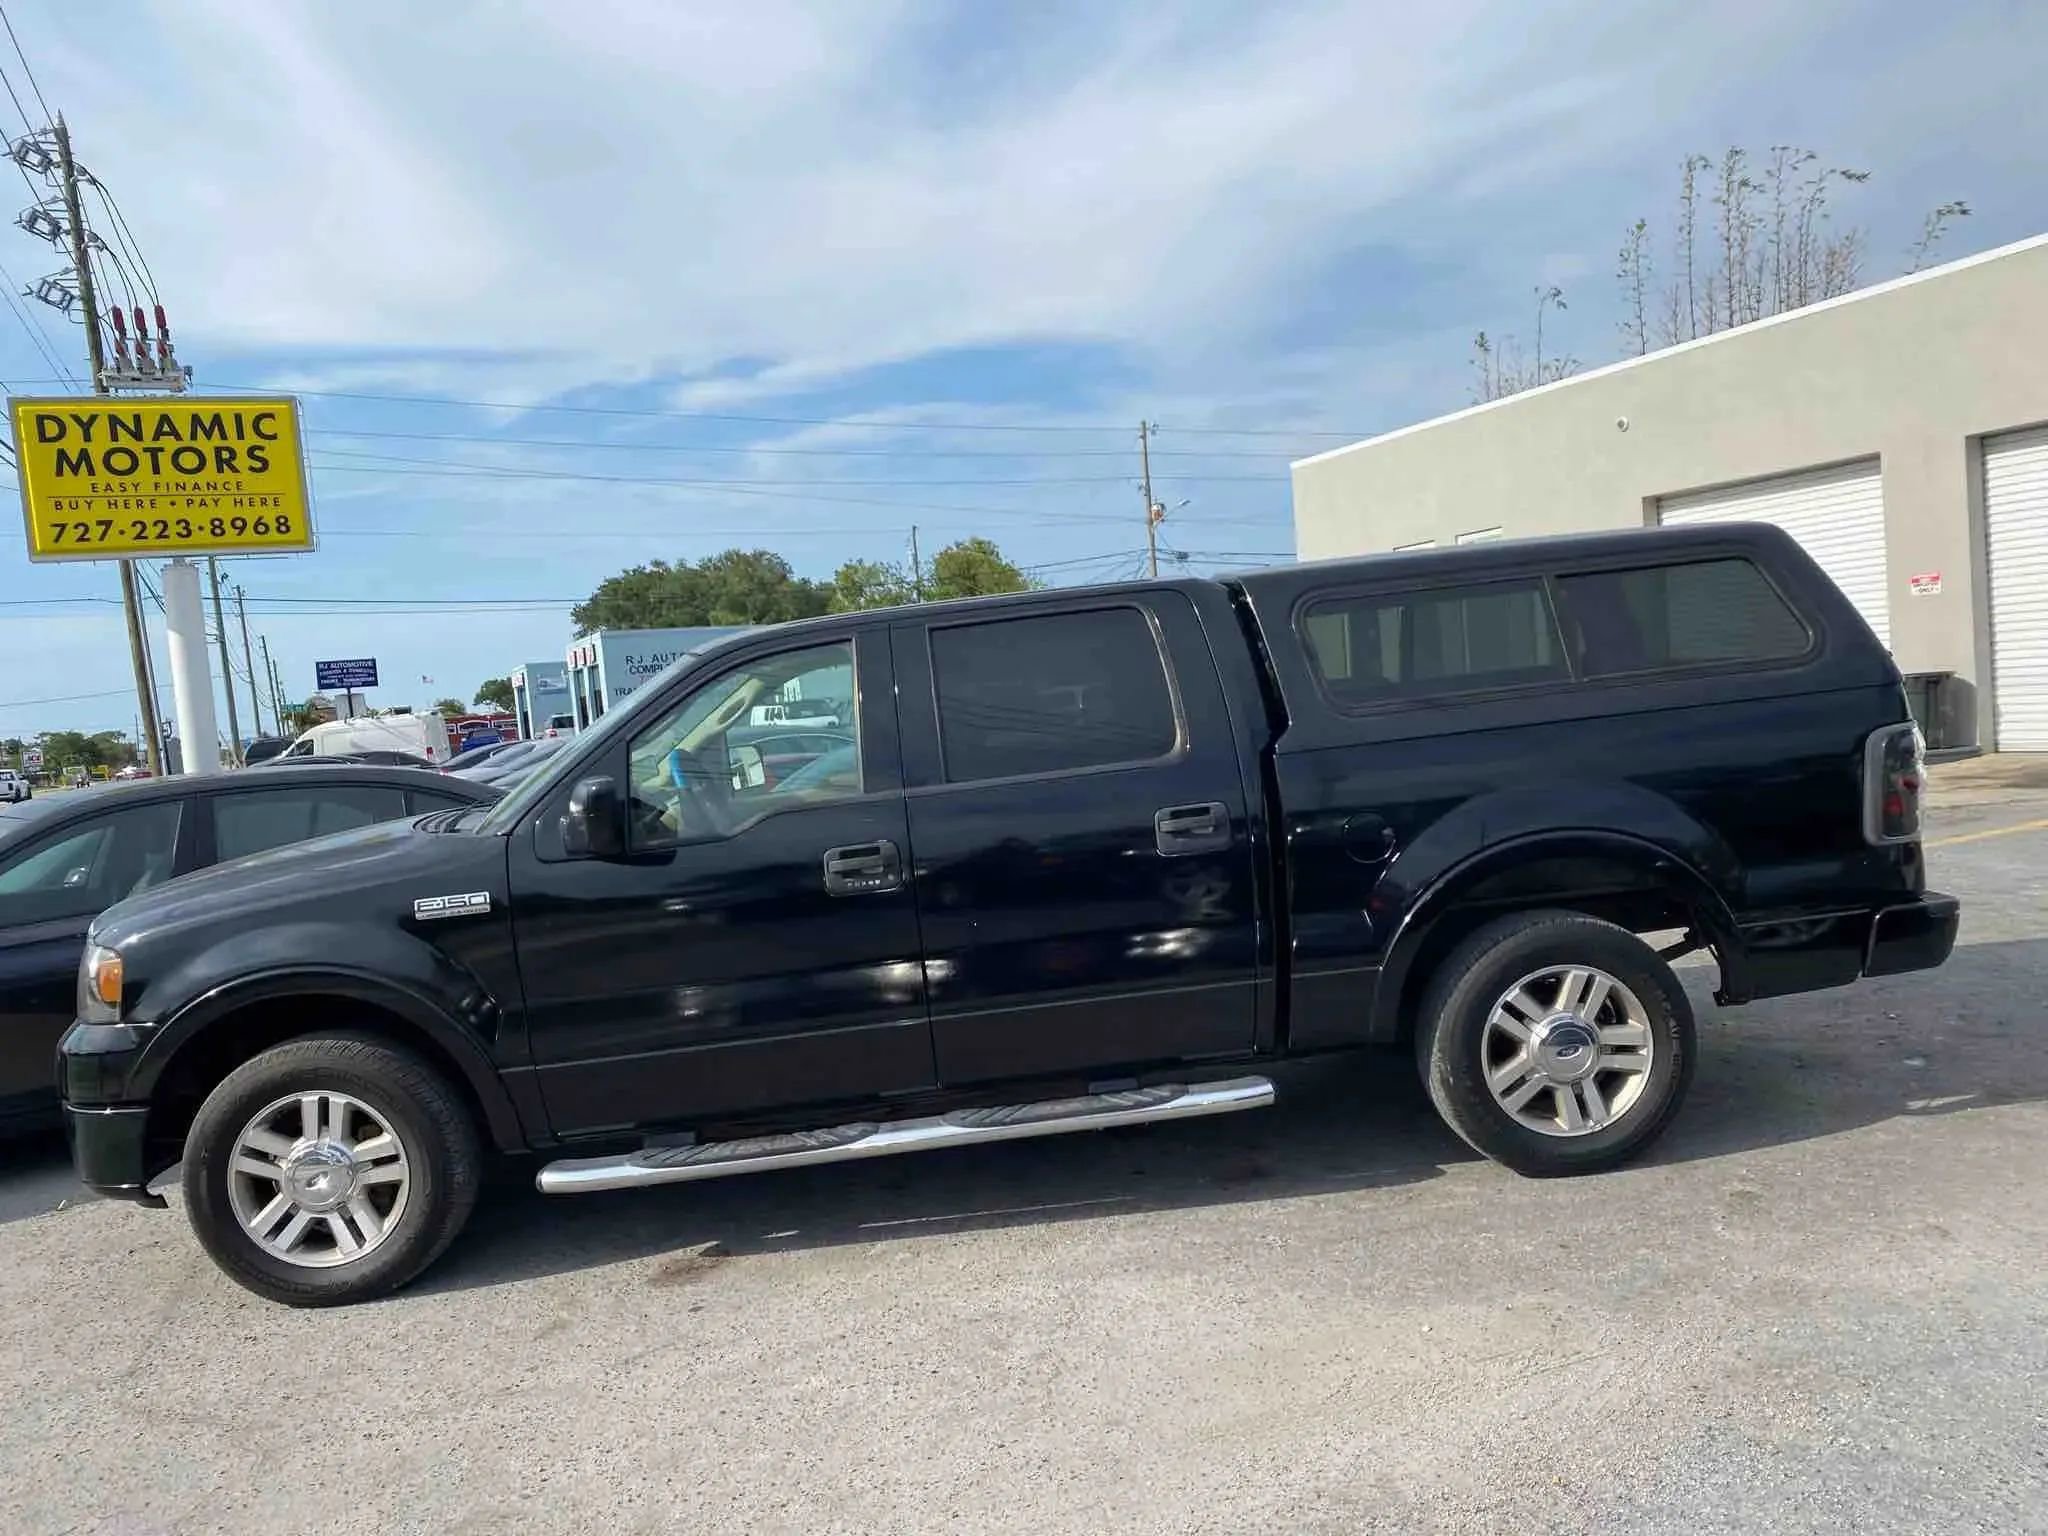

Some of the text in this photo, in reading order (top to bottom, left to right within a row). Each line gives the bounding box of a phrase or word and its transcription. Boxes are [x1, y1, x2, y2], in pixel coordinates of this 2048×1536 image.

[35, 412, 279, 443] DYNAMIC
[55, 444, 270, 478] MOTORS
[91, 481, 245, 494] EASY FINANCE
[54, 496, 281, 511] BUY HERE PAY HERE
